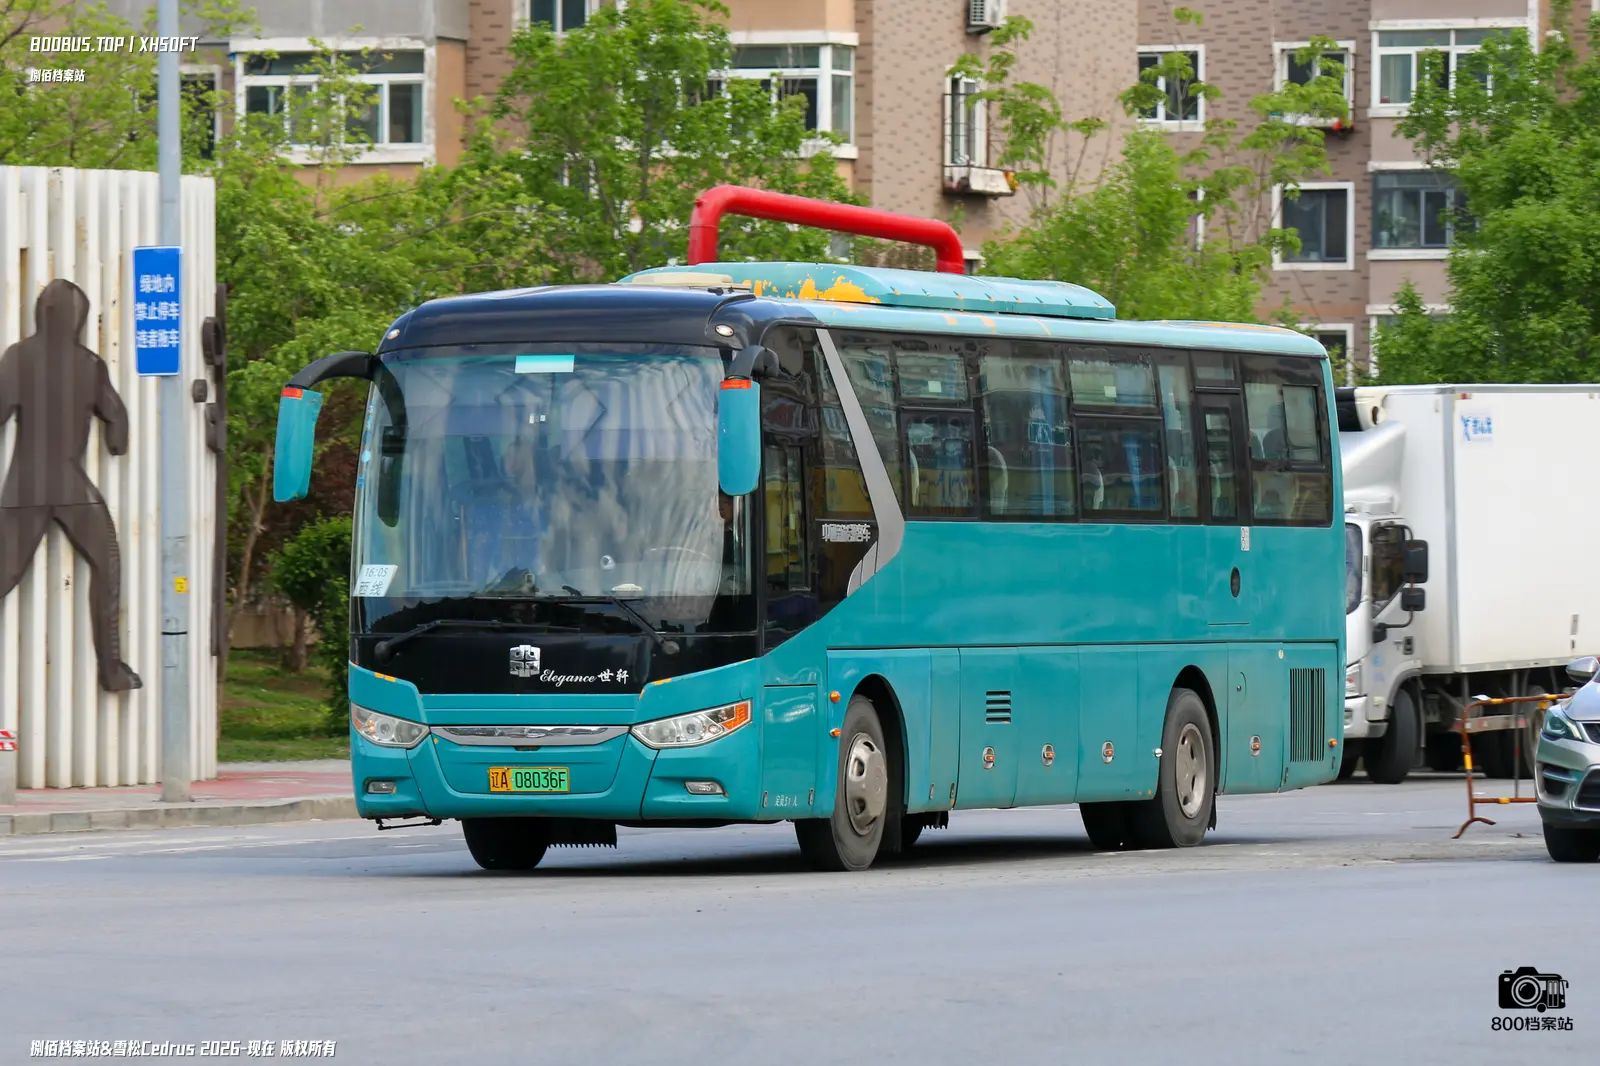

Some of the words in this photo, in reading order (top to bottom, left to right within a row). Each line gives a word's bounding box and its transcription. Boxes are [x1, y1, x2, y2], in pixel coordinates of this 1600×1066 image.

[135, 301, 180, 321] 禁止停车
[364, 567, 389, 578] 16:05
[540, 668, 598, 687] Elegance
[597, 668, 629, 685] 世轩
[491, 771, 509, 788] 辽A
[514, 771, 566, 788] 08036F
